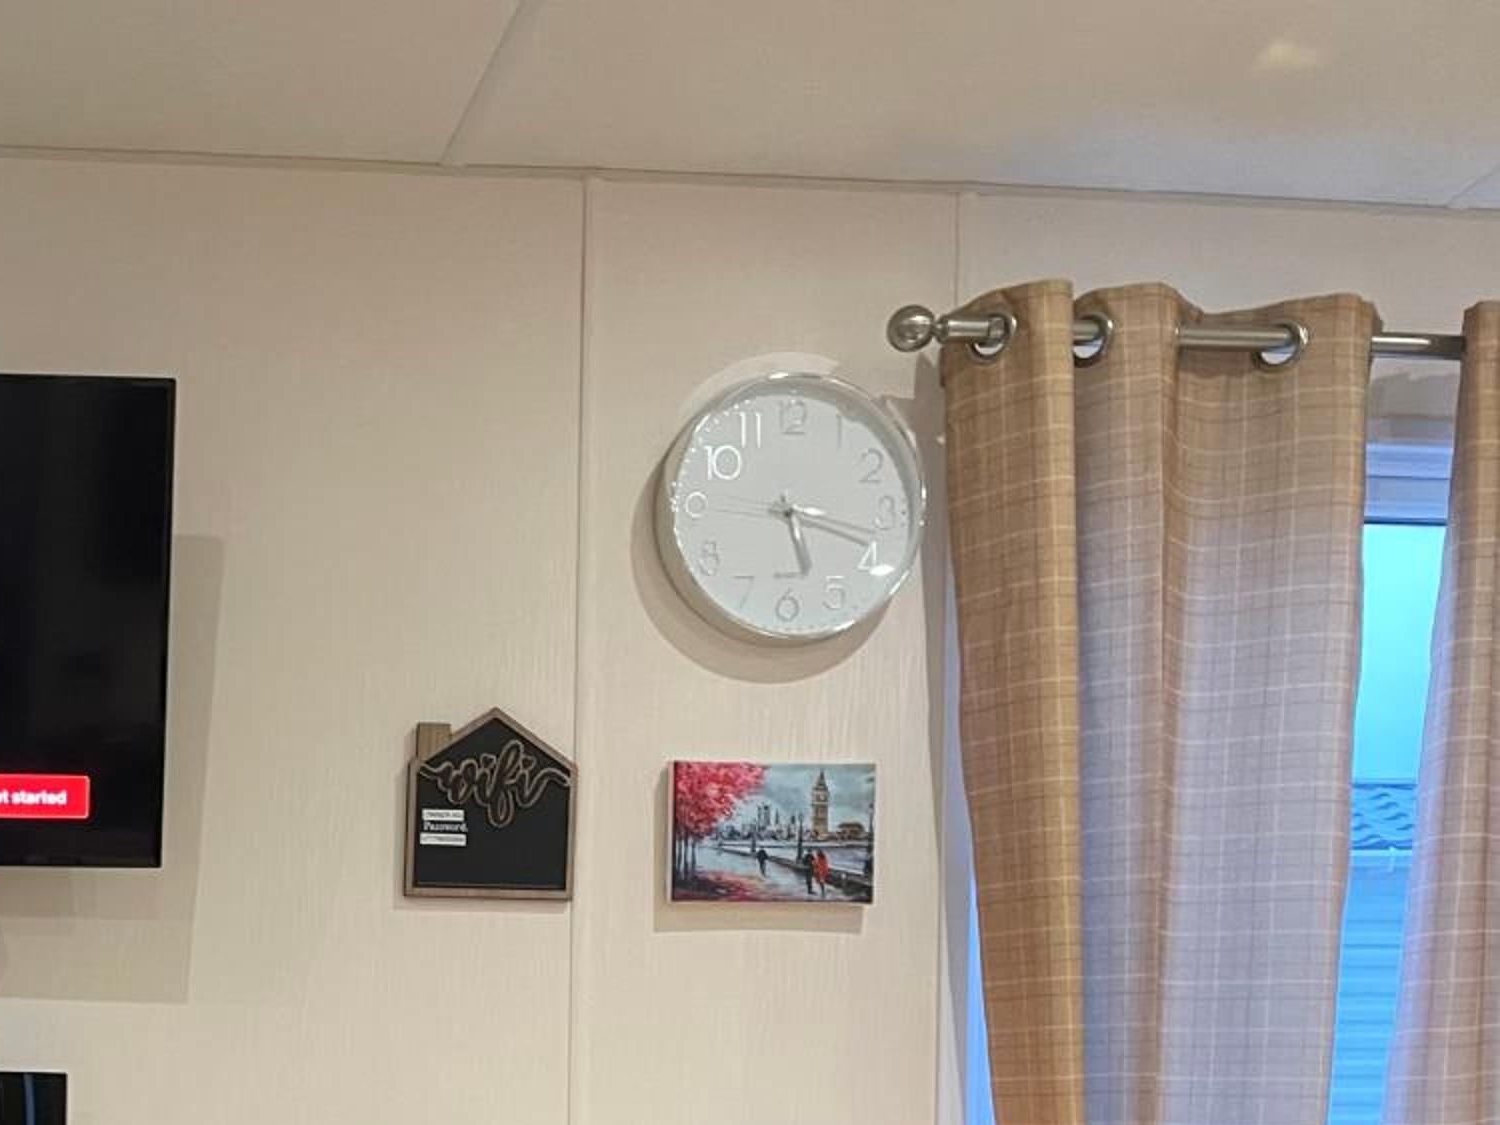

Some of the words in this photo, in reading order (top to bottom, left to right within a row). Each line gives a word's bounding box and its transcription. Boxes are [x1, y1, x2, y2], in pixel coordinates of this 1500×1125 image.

[738, 411, 762, 448] 11
[778, 398, 807, 435] 12
[704, 444, 741, 481] 10
[859, 447, 883, 484] 2
[874, 495, 896, 531] 3
[857, 540, 879, 571] 4
[732, 574, 755, 609] 7
[774, 587, 800, 622] 6
[821, 574, 846, 611] 5
[11, 788, 68, 806] started
[419, 739, 572, 828] wifi
